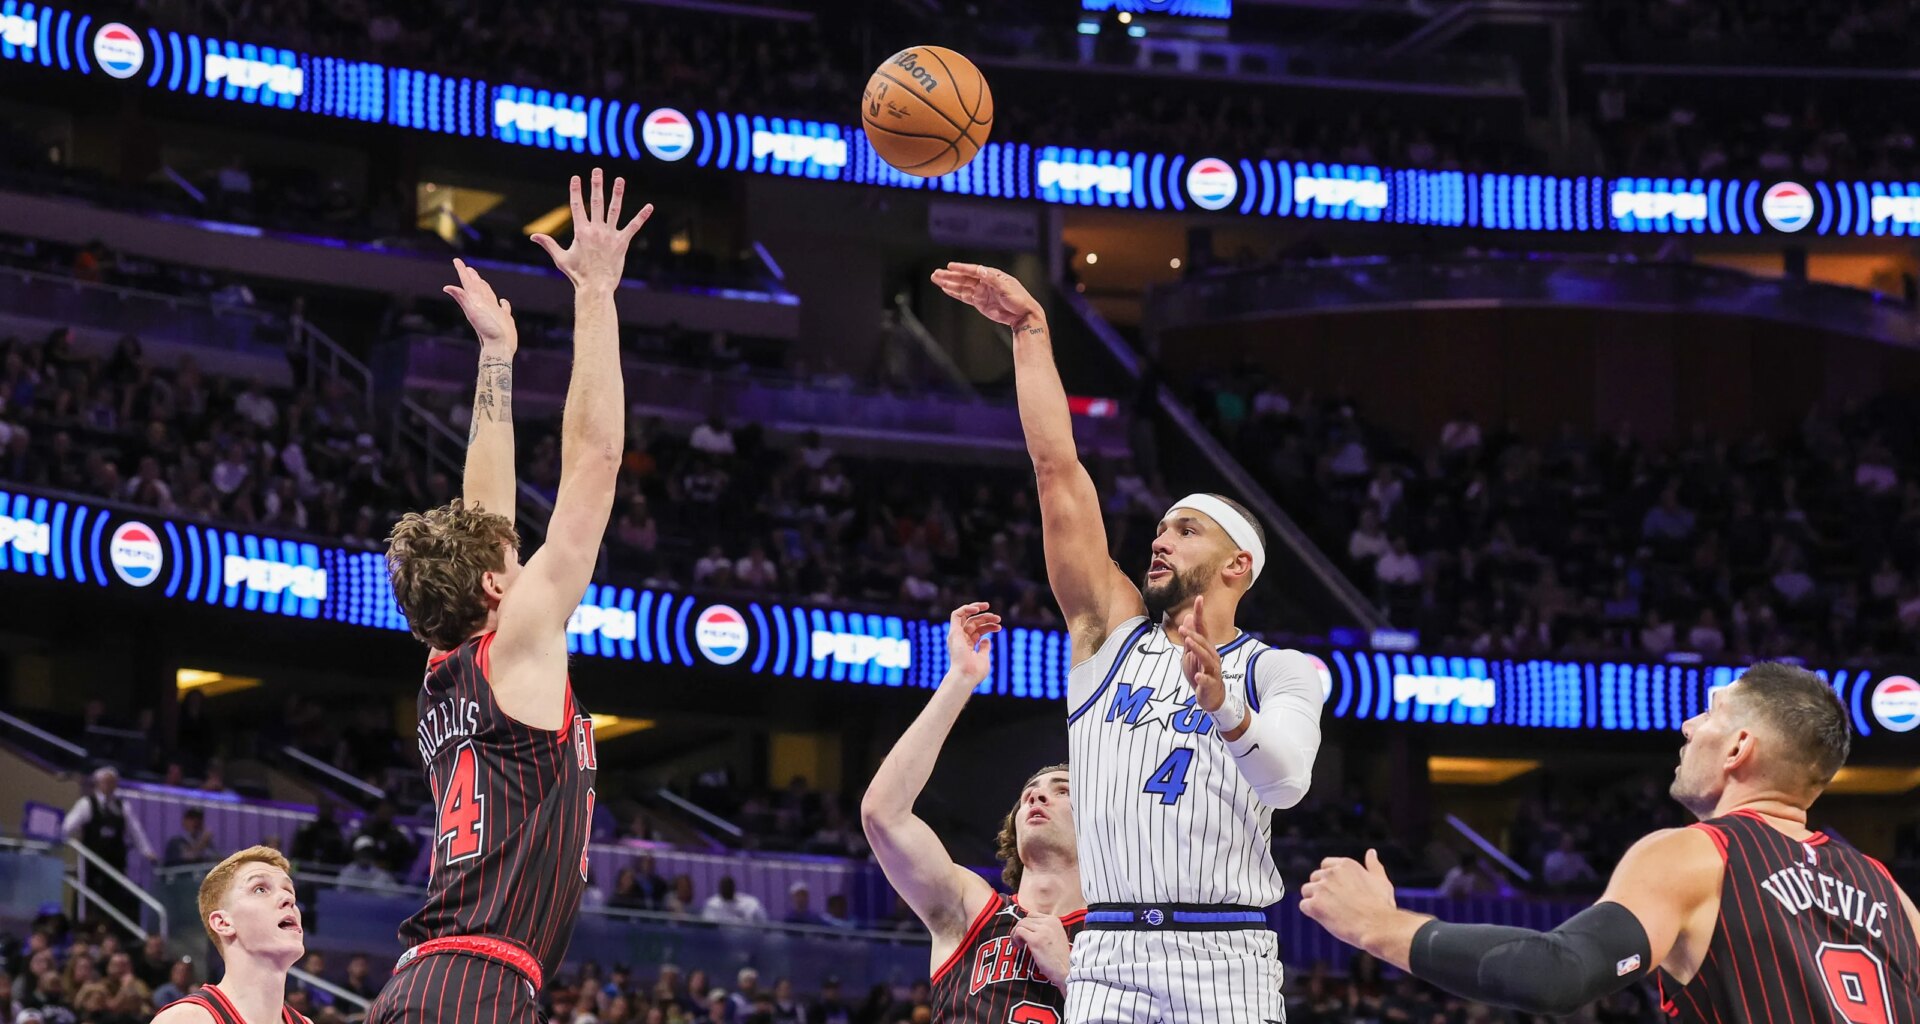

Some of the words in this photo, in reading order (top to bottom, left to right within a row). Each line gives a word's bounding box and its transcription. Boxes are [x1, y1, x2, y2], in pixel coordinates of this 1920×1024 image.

[205, 53, 304, 96] PEPSI
[893, 50, 937, 92] ilson
[495, 98, 587, 139] PEPSI
[752, 130, 847, 167] PEPSI
[1038, 159, 1131, 193] PEPSI
[1294, 175, 1388, 209] PEPSI
[1612, 191, 1707, 220] PEPSI
[224, 554, 327, 600] PEPSI
[811, 630, 911, 669] PEPSI
[1393, 673, 1495, 718] PEPSI
[1142, 747, 1195, 805] 4
